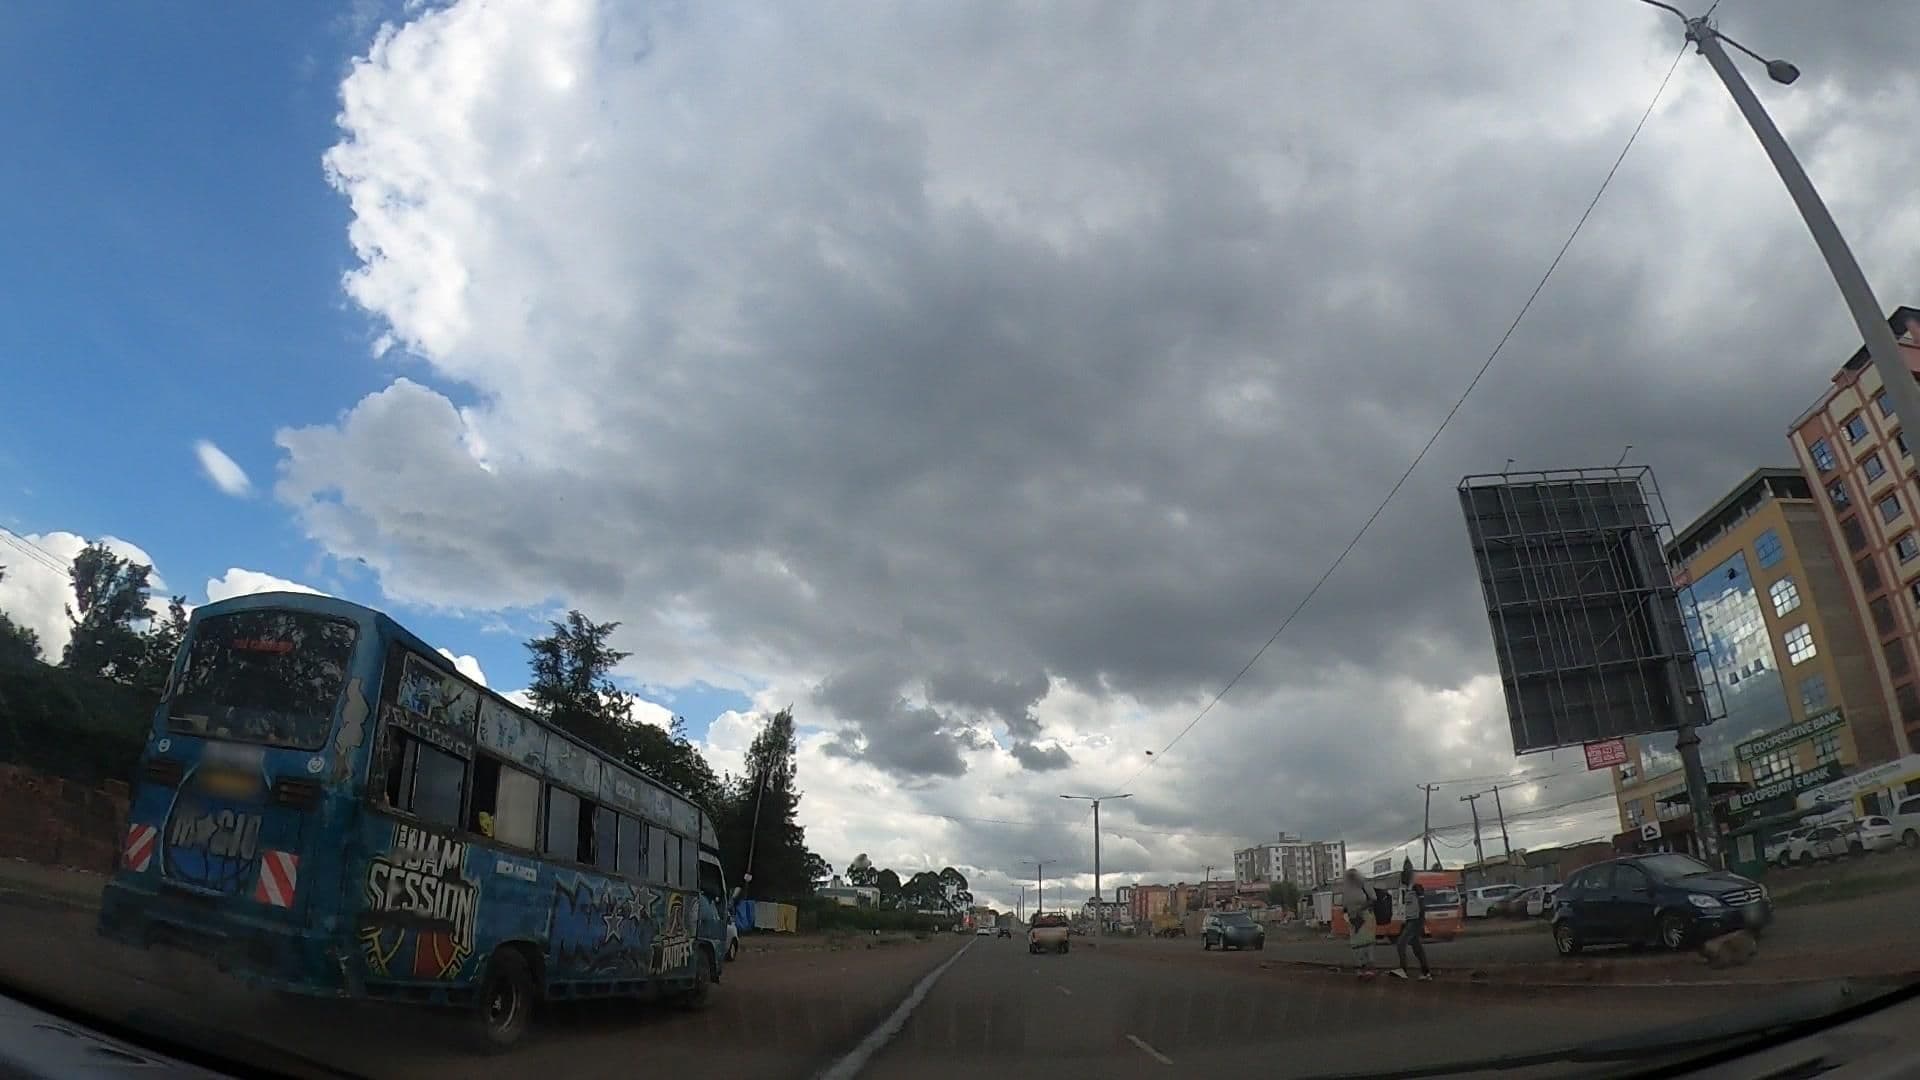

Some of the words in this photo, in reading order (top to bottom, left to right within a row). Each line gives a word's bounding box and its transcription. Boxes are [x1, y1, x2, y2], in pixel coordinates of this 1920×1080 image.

[1813, 711, 1841, 729] BANK
[1741, 777, 1802, 805] CO-OPERATIE
[1803, 767, 1830, 786] BANK
[404, 830, 462, 877] JAM
[369, 862, 474, 949] SESSION
